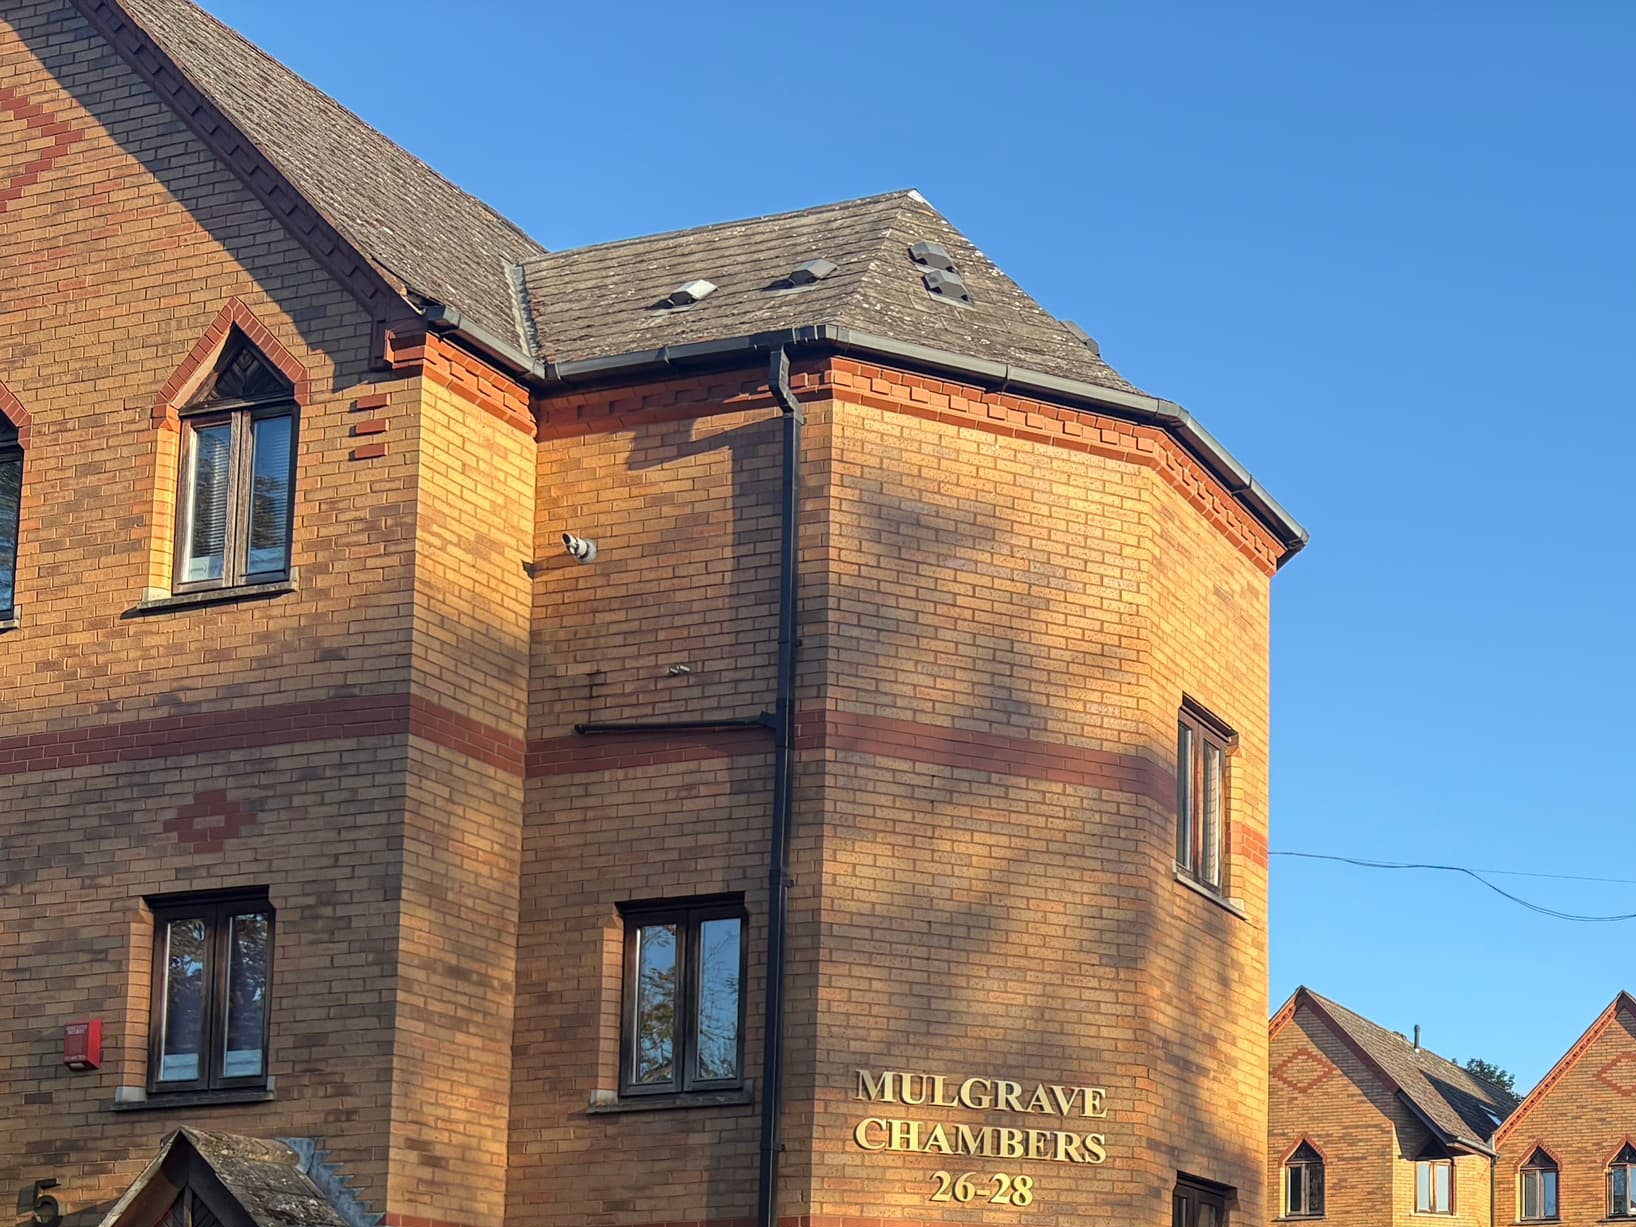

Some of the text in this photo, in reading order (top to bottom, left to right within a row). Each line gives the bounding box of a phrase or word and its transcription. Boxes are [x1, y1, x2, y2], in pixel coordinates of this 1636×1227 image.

[855, 1069, 1108, 1118] MULGRAVE
[855, 1117, 1107, 1164] CHAMBERS
[930, 1170, 1034, 1206] 26-28
